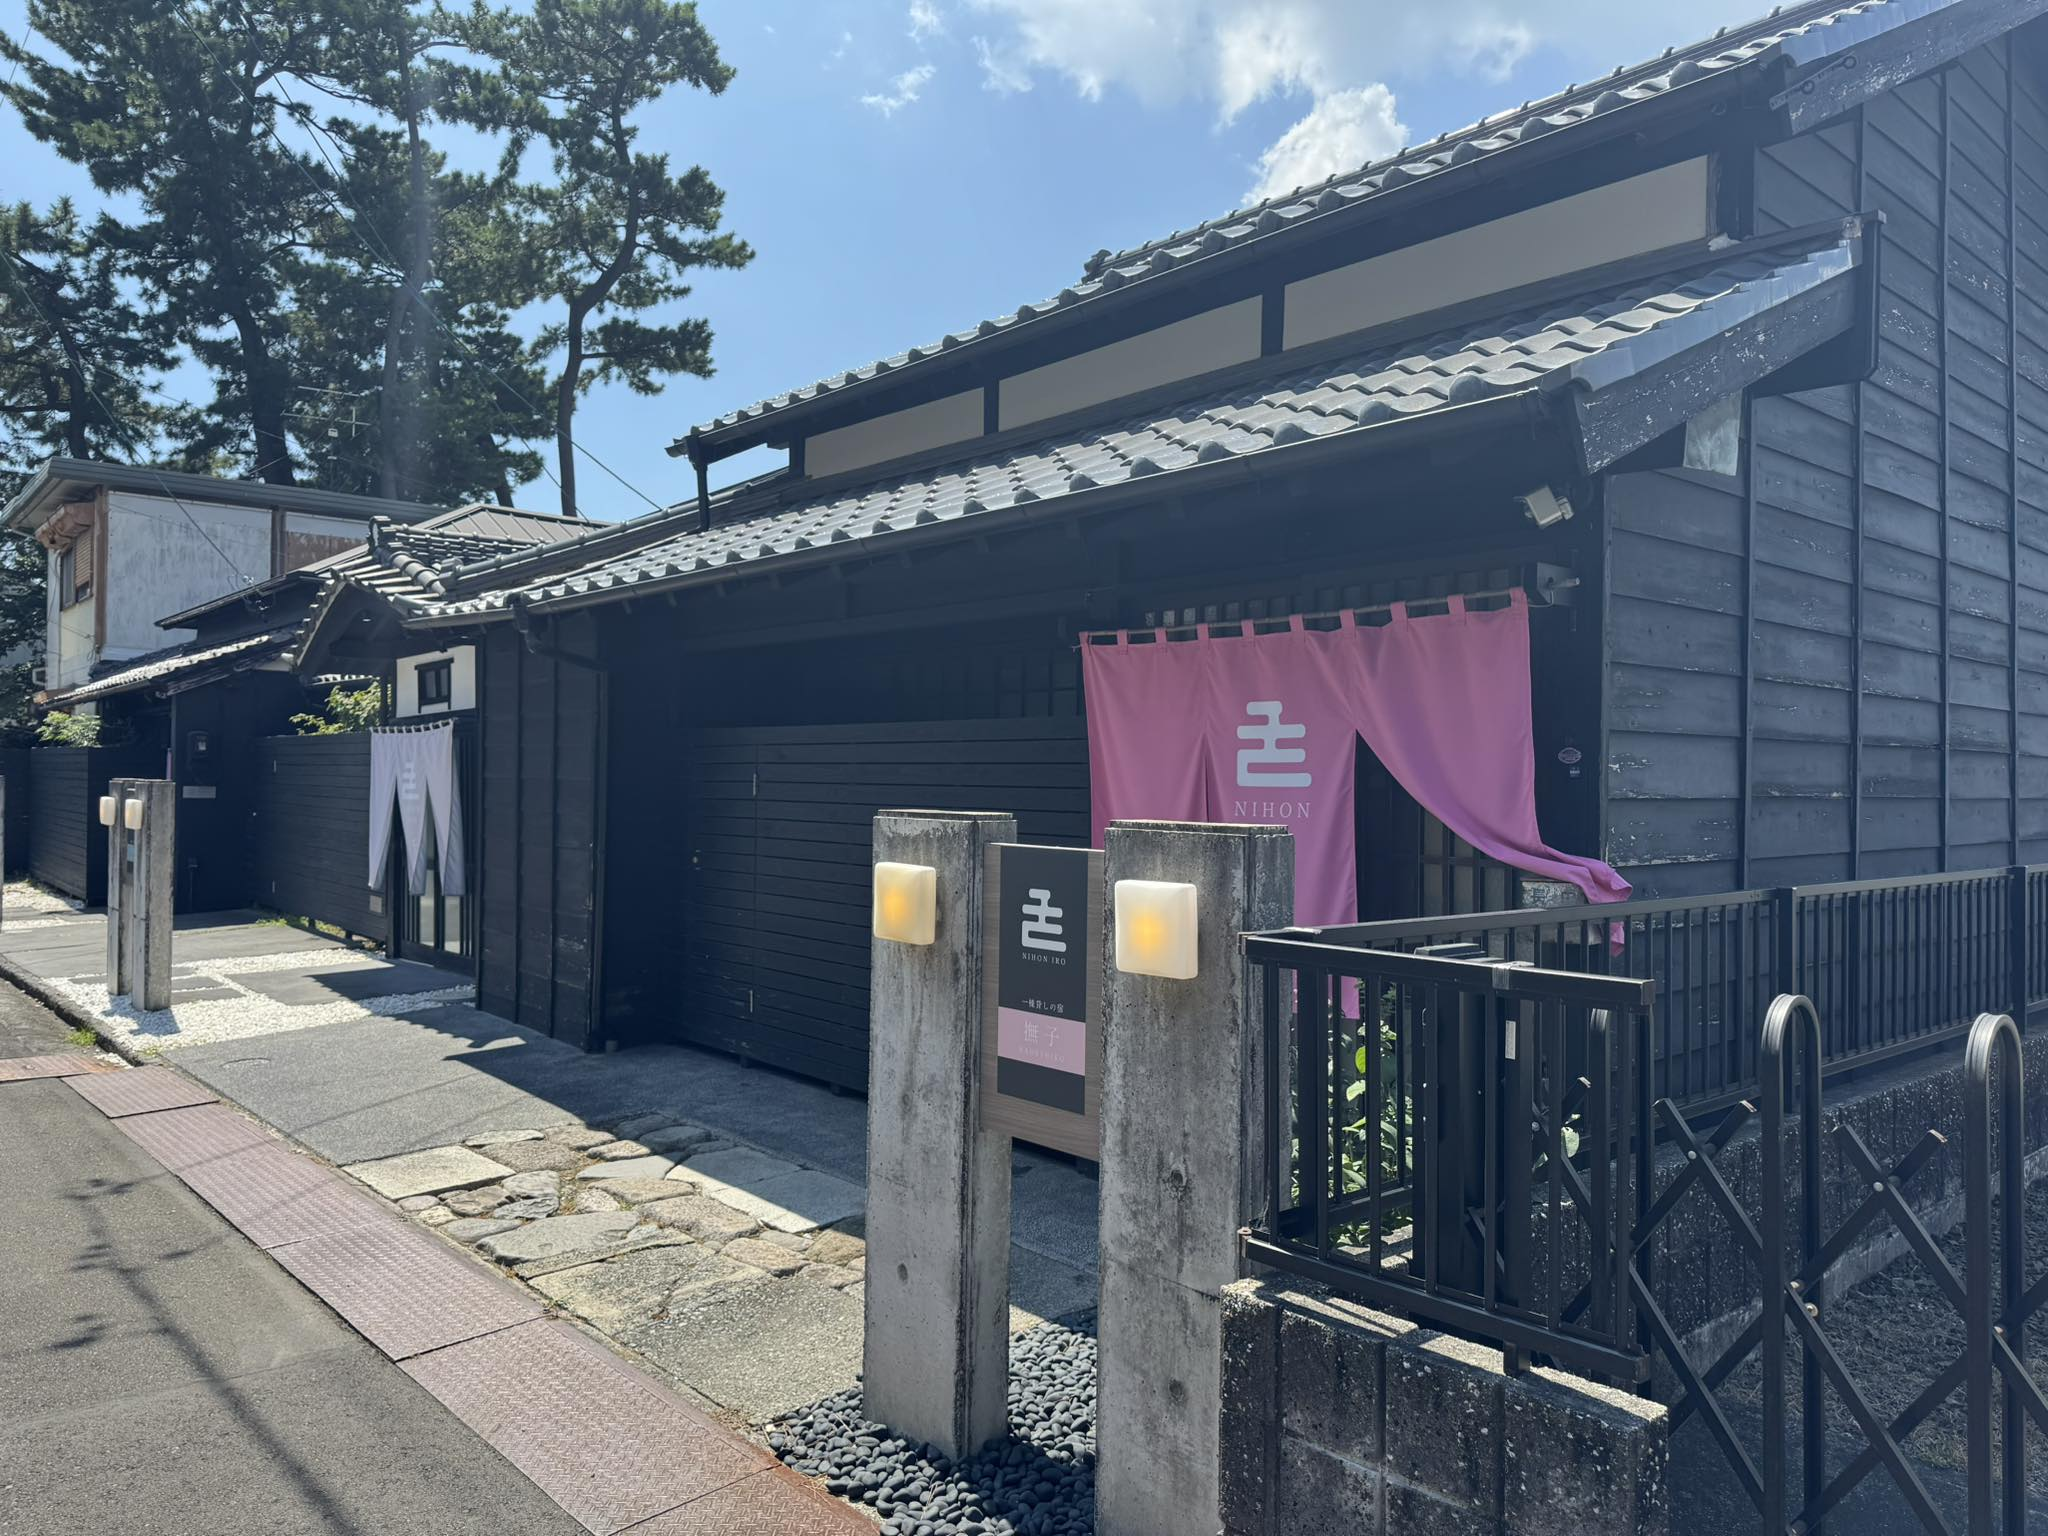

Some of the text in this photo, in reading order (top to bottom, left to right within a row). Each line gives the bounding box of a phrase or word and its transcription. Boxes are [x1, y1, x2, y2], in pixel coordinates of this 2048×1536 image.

[1234, 801, 1311, 818] NIHON
[1021, 952, 1066, 966] NIHON IRO
